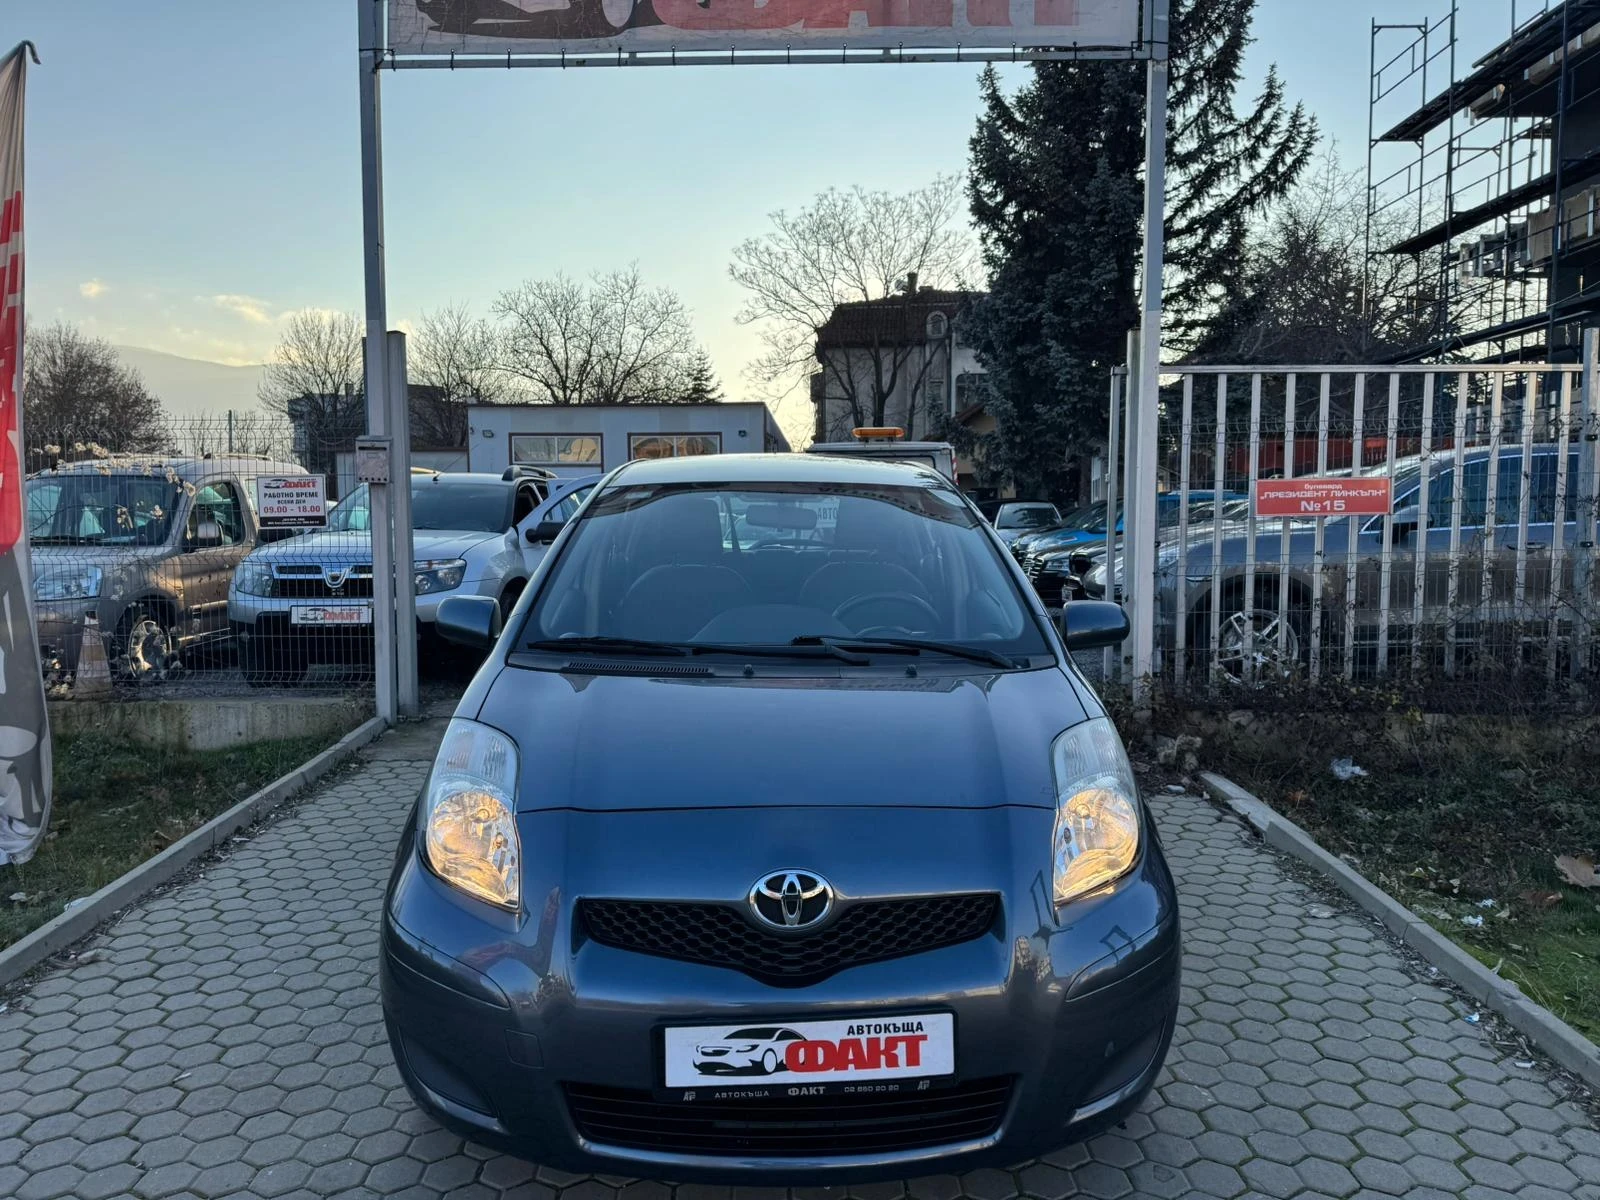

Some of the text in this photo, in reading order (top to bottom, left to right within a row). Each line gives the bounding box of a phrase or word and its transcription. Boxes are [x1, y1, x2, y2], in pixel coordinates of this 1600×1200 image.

[847, 1021, 924, 1036] АВТОКЪЩА
[784, 1034, 928, 1073] ФАКТ
[788, 1085, 826, 1095] ФАКТ
